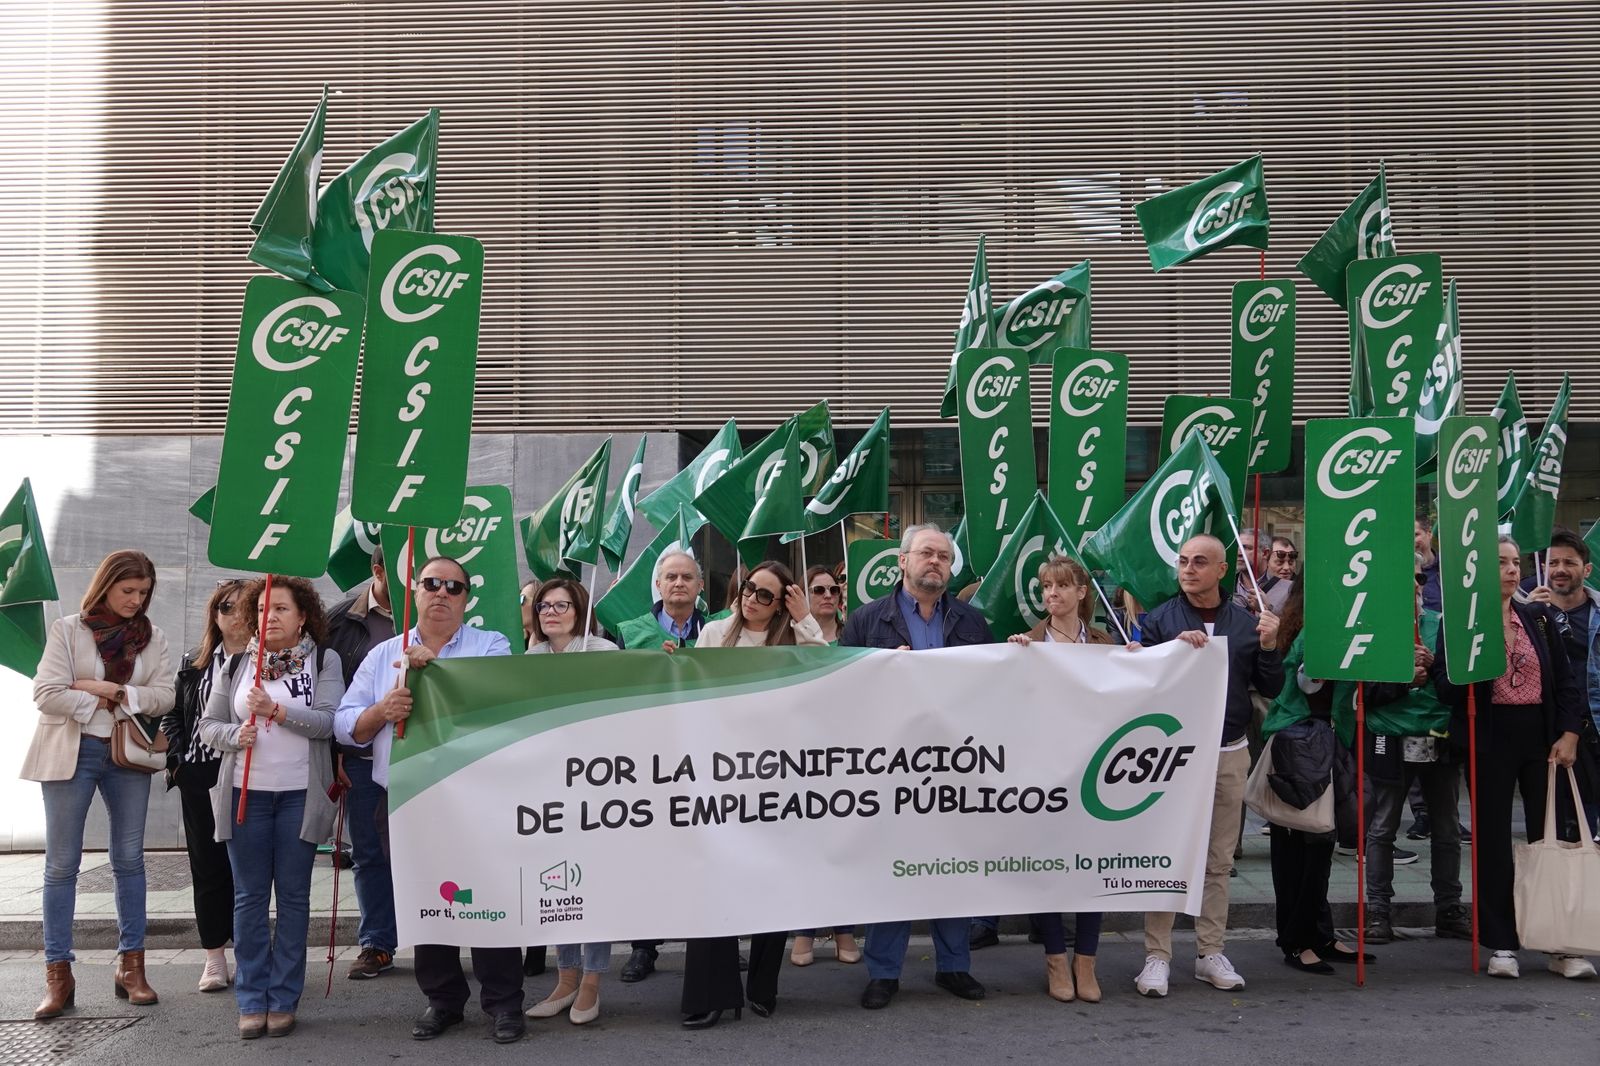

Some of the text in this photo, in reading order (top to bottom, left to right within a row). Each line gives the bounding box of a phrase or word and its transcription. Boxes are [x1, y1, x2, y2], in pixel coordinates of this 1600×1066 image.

[1198, 192, 1256, 235] CSIF
[398, 267, 470, 298] CSIF
[1373, 282, 1431, 308] CSIF
[1010, 298, 1077, 332] CSIF
[1249, 302, 1289, 324] CSIF
[272, 317, 350, 352] CSIF
[976, 375, 1021, 399] CSIF
[1072, 375, 1120, 399] CSIF
[387, 336, 439, 512] CSIF
[248, 387, 312, 560] CSIF
[1334, 449, 1402, 475] CSIF
[1454, 448, 1492, 475] CSIF
[1166, 471, 1211, 544] CSIF
[1340, 508, 1376, 669] CSIF
[1461, 508, 1485, 672] CSIF
[566, 736, 1005, 787] POR LA DIGNIFICACIÓN
[1104, 745, 1195, 784] CSIF
[516, 776, 1069, 836] DE LOS EMPLEADOS PÚBLICOS
[892, 853, 1172, 878] Servicios públicos, lo primero
[1103, 877, 1187, 890] Tú lo mereces
[420, 908, 506, 921] por ti, contigo
[539, 895, 583, 908] tu voto
[540, 913, 583, 924] palabra
